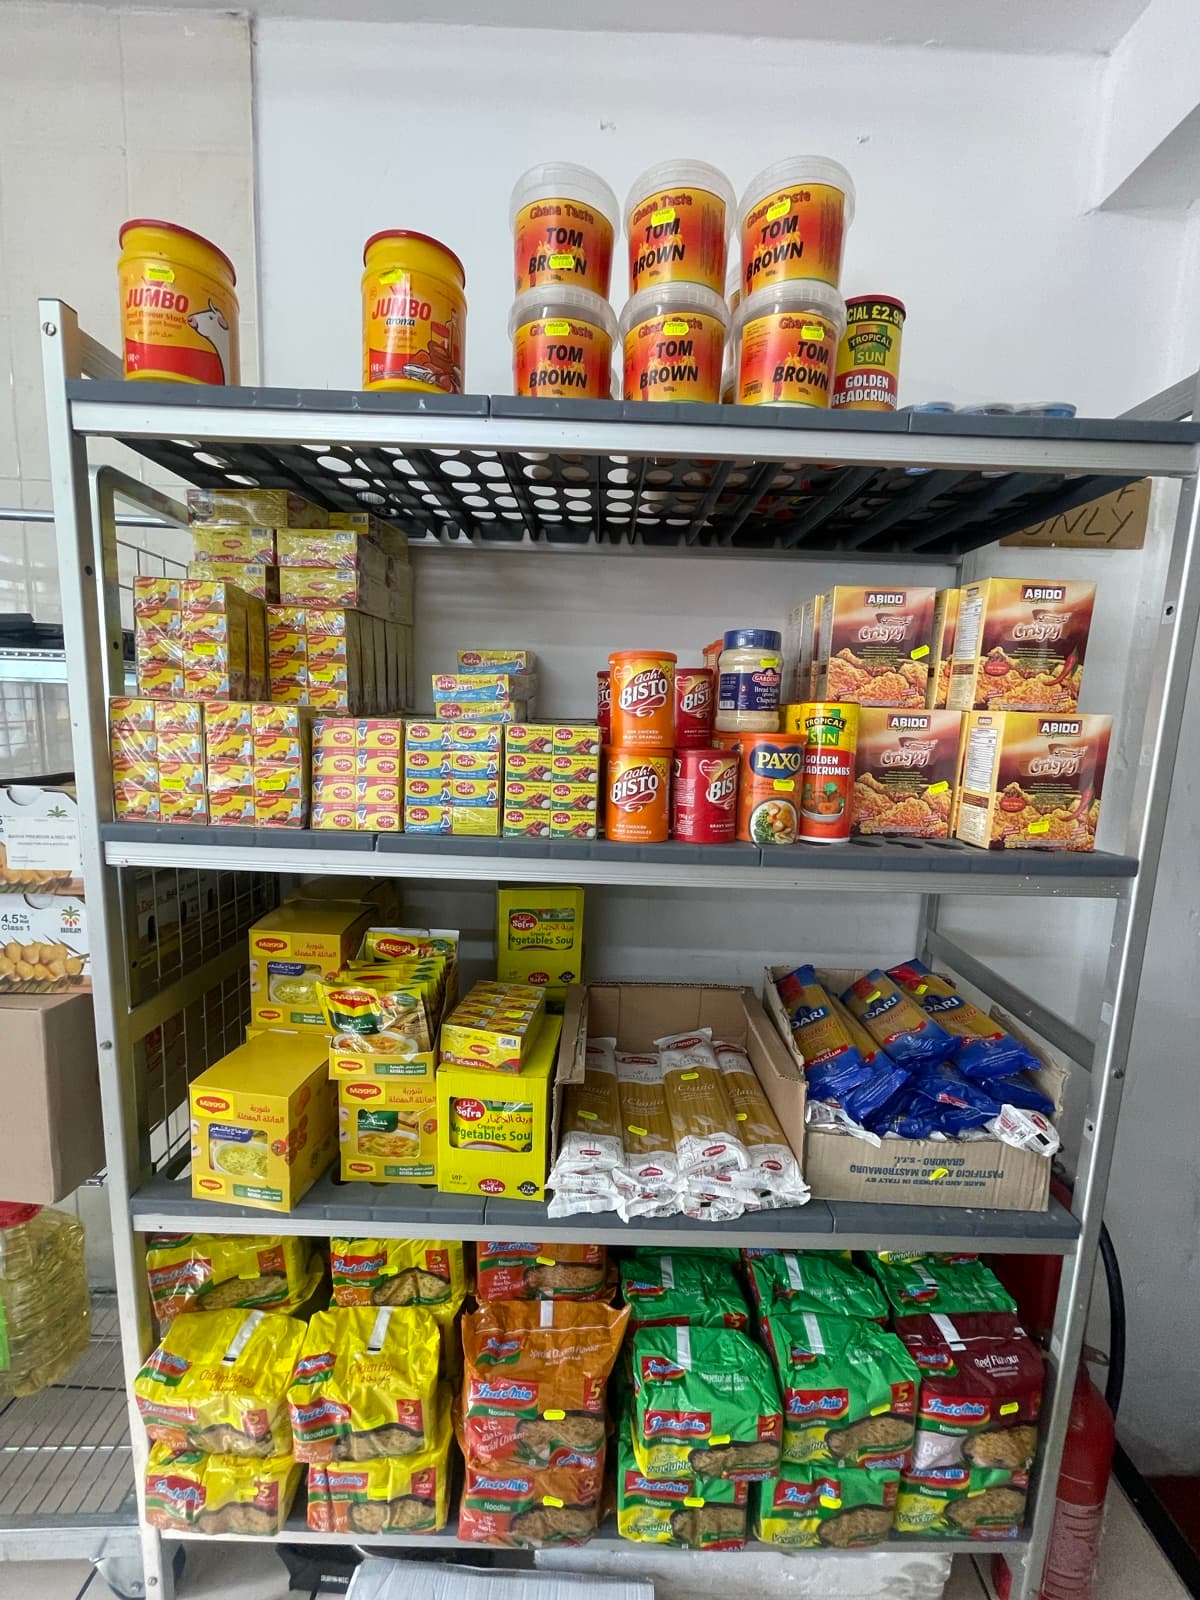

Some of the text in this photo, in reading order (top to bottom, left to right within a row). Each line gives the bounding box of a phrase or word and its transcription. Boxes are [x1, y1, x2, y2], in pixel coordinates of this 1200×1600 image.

[546, 227, 584, 247] TOM
[645, 218, 681, 242] TOM
[761, 215, 799, 243] TOM
[529, 253, 587, 275] BRN
[633, 244, 686, 280] BROWN
[746, 241, 804, 282] BROWN
[127, 287, 189, 313] JUMBO
[372, 297, 432, 320] JUMBO
[850, 333, 891, 349] TROPICAL
[547, 345, 584, 363] TOM
[656, 340, 693, 360] TOM
[798, 341, 829, 364] TOM
[857, 350, 885, 364] SUN
[529, 369, 588, 389] BROWN
[640, 365, 699, 389] BROWN
[773, 364, 830, 391] BROWN
[845, 374, 890, 388] GOLDEN
[868, 594, 904, 605] ABIDO
[1024, 588, 1062, 600] ABIDO
[858, 625, 906, 643] Crispy
[1012, 621, 1064, 641] Crispy
[633, 669, 661, 684] aah!
[621, 679, 668, 707] BISTO
[806, 717, 844, 728] TROPICAL
[891, 717, 928, 728] ABIDO
[1041, 722, 1080, 734] ABIDO
[757, 751, 801, 770] PAXO
[805, 755, 839, 765] GOLDEN
[880, 748, 932, 767] Crispy
[623, 764, 652, 780] aah!
[1028, 756, 1079, 776] Crispy
[612, 775, 659, 801] BISTO
[1, 914, 19, 924] 4.5
[512, 919, 534, 929] Sofra
[1, 924, 26, 932] Class
[864, 996, 898, 1019] DARI
[923, 996, 960, 1013] DARI
[791, 1007, 825, 1029] DARI
[456, 1105, 482, 1119] Sofra
[849, 1164, 919, 1177] MASTROMAURO
[956, 1169, 1004, 1179] PASTIFICIO
[480, 1184, 504, 1193] Sofra
[486, 1242, 539, 1254] Indomie
[991, 1353, 1020, 1366] Flavour
[477, 1383, 534, 1401] Indomie
[589, 1380, 601, 1396] 5
[899, 1385, 909, 1399] 5
[403, 1403, 416, 1416] 5
[488, 1407, 516, 1418] Noodles
[789, 1396, 843, 1415] Indomie
[928, 1397, 985, 1416] Indomie
[648, 1416, 706, 1433] Indomie
[938, 1422, 970, 1434] Noodles
[303, 1427, 334, 1440] Noodles
[260, 1485, 269, 1497] 5
[474, 1475, 529, 1491] Indomie
[634, 1476, 690, 1494] Indomie
[484, 1502, 511, 1512] Noodles
[645, 1498, 672, 1507] Noodles
